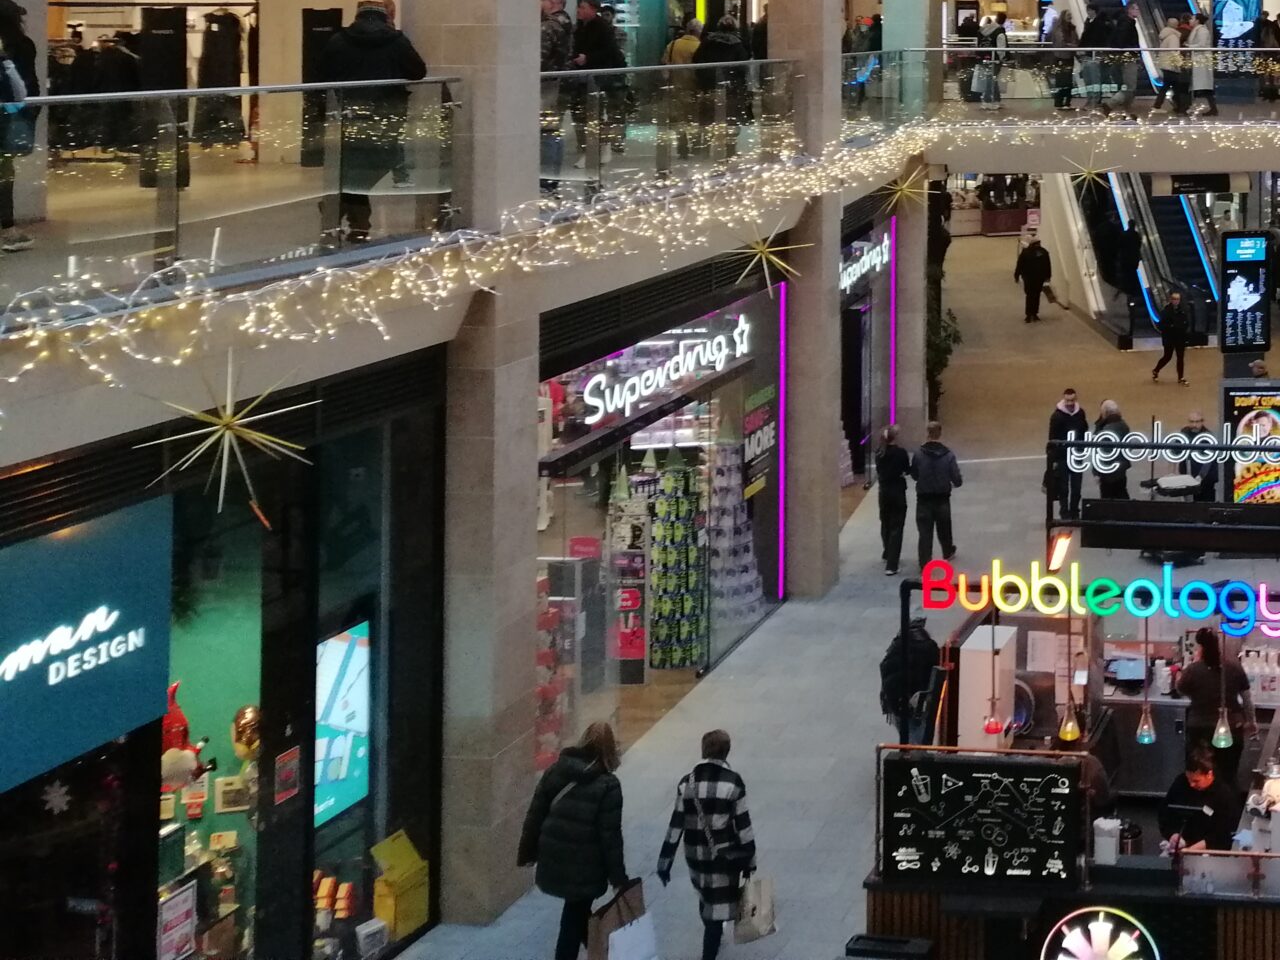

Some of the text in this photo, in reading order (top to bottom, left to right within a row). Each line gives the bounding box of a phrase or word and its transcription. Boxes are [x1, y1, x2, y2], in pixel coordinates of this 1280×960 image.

[583, 334, 729, 425] Superdrug
[743, 421, 776, 463] MORE
[48, 627, 146, 686] DESIGN
